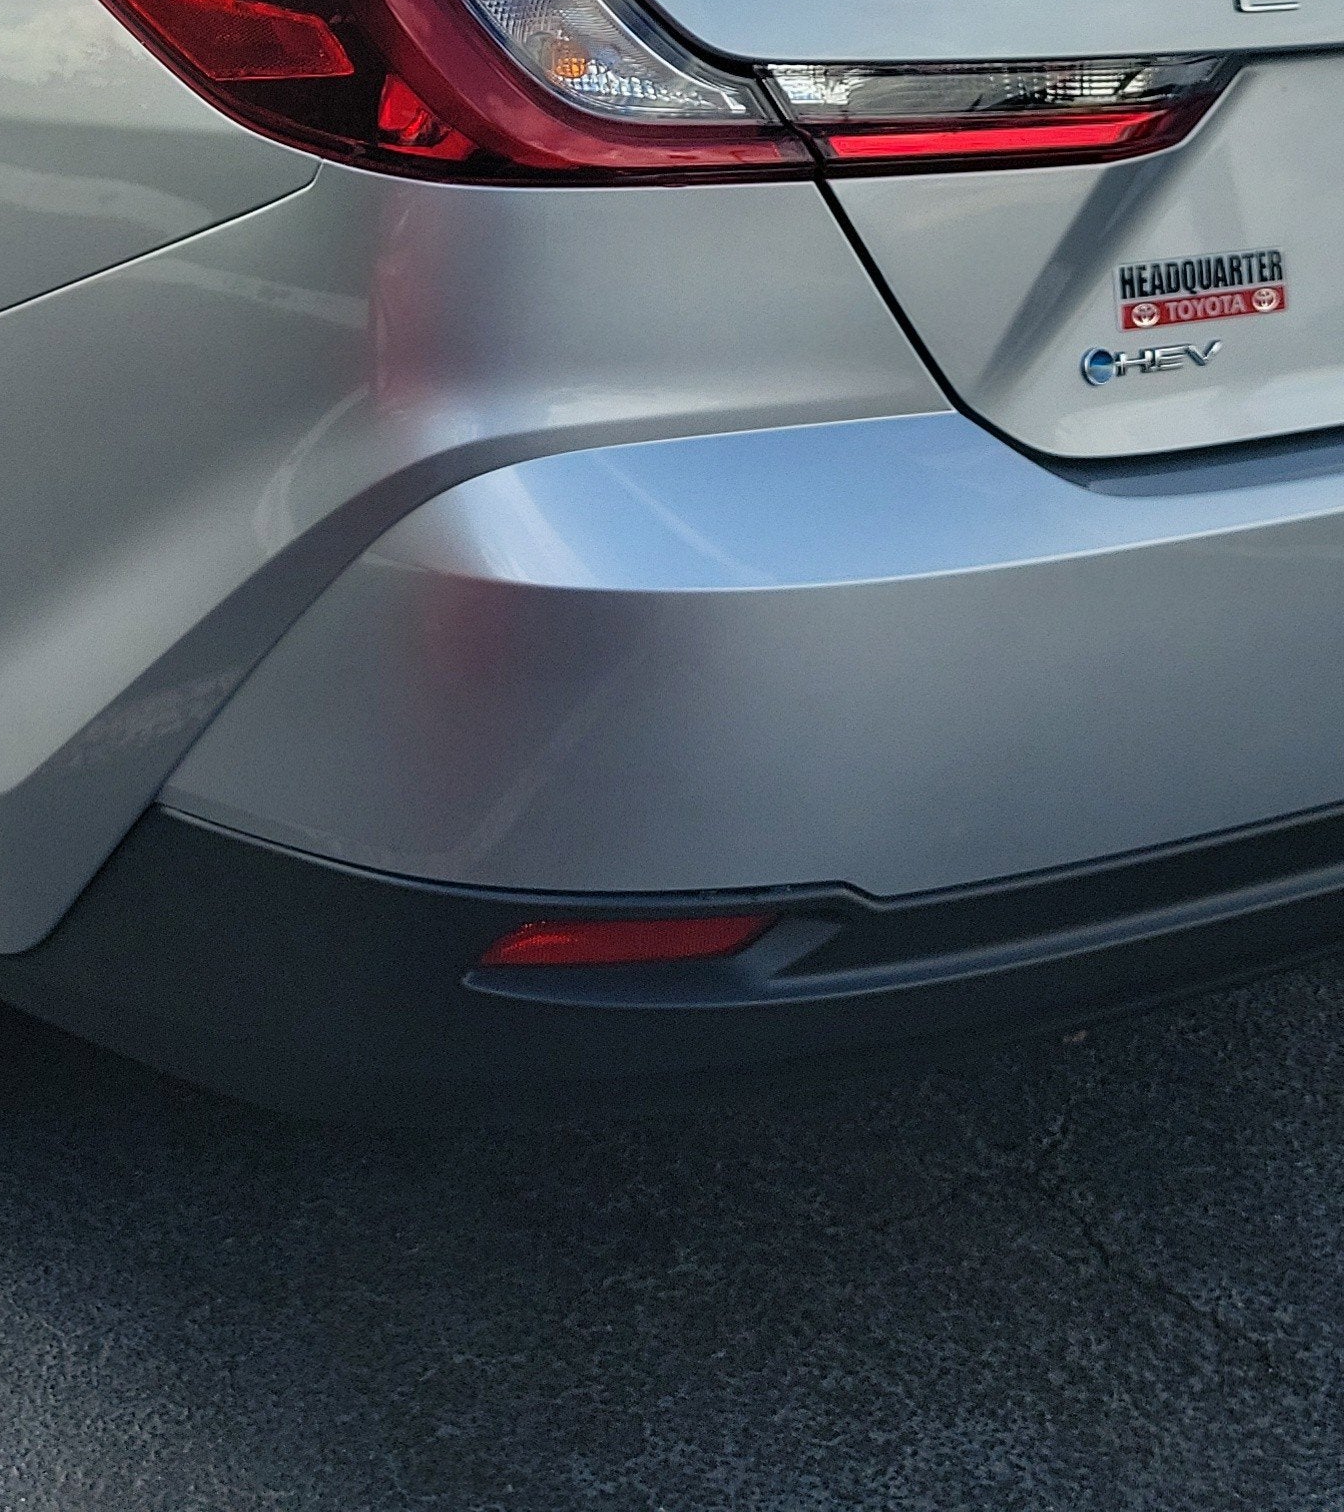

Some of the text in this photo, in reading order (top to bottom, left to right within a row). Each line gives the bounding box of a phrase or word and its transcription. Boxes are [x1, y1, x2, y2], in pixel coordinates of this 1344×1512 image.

[1119, 250, 1284, 300] HEADQUARTER
[1165, 293, 1246, 322] TOYOTA
[1115, 339, 1223, 378] HEV
